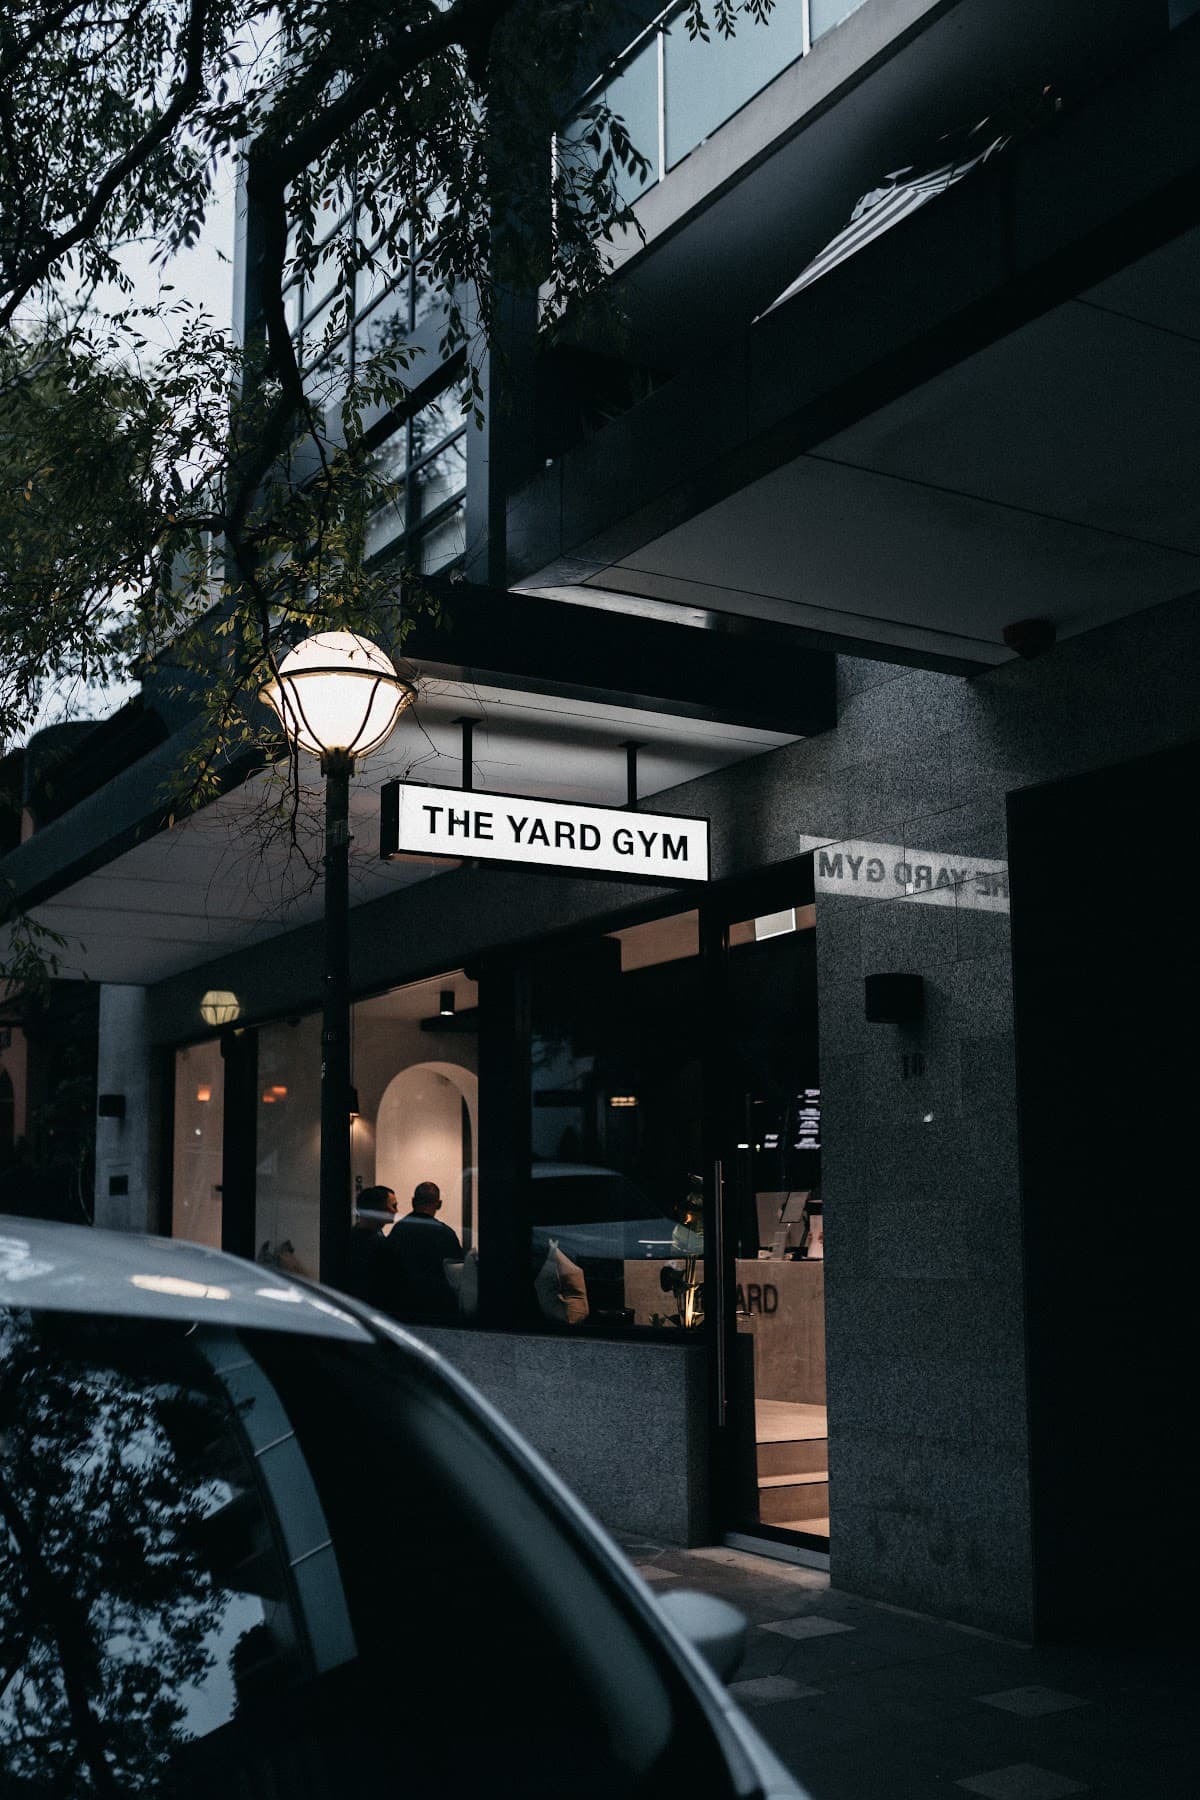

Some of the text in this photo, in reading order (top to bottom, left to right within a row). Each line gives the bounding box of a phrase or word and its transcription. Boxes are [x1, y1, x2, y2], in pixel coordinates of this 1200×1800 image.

[423, 805, 688, 861] THE YARD GYM
